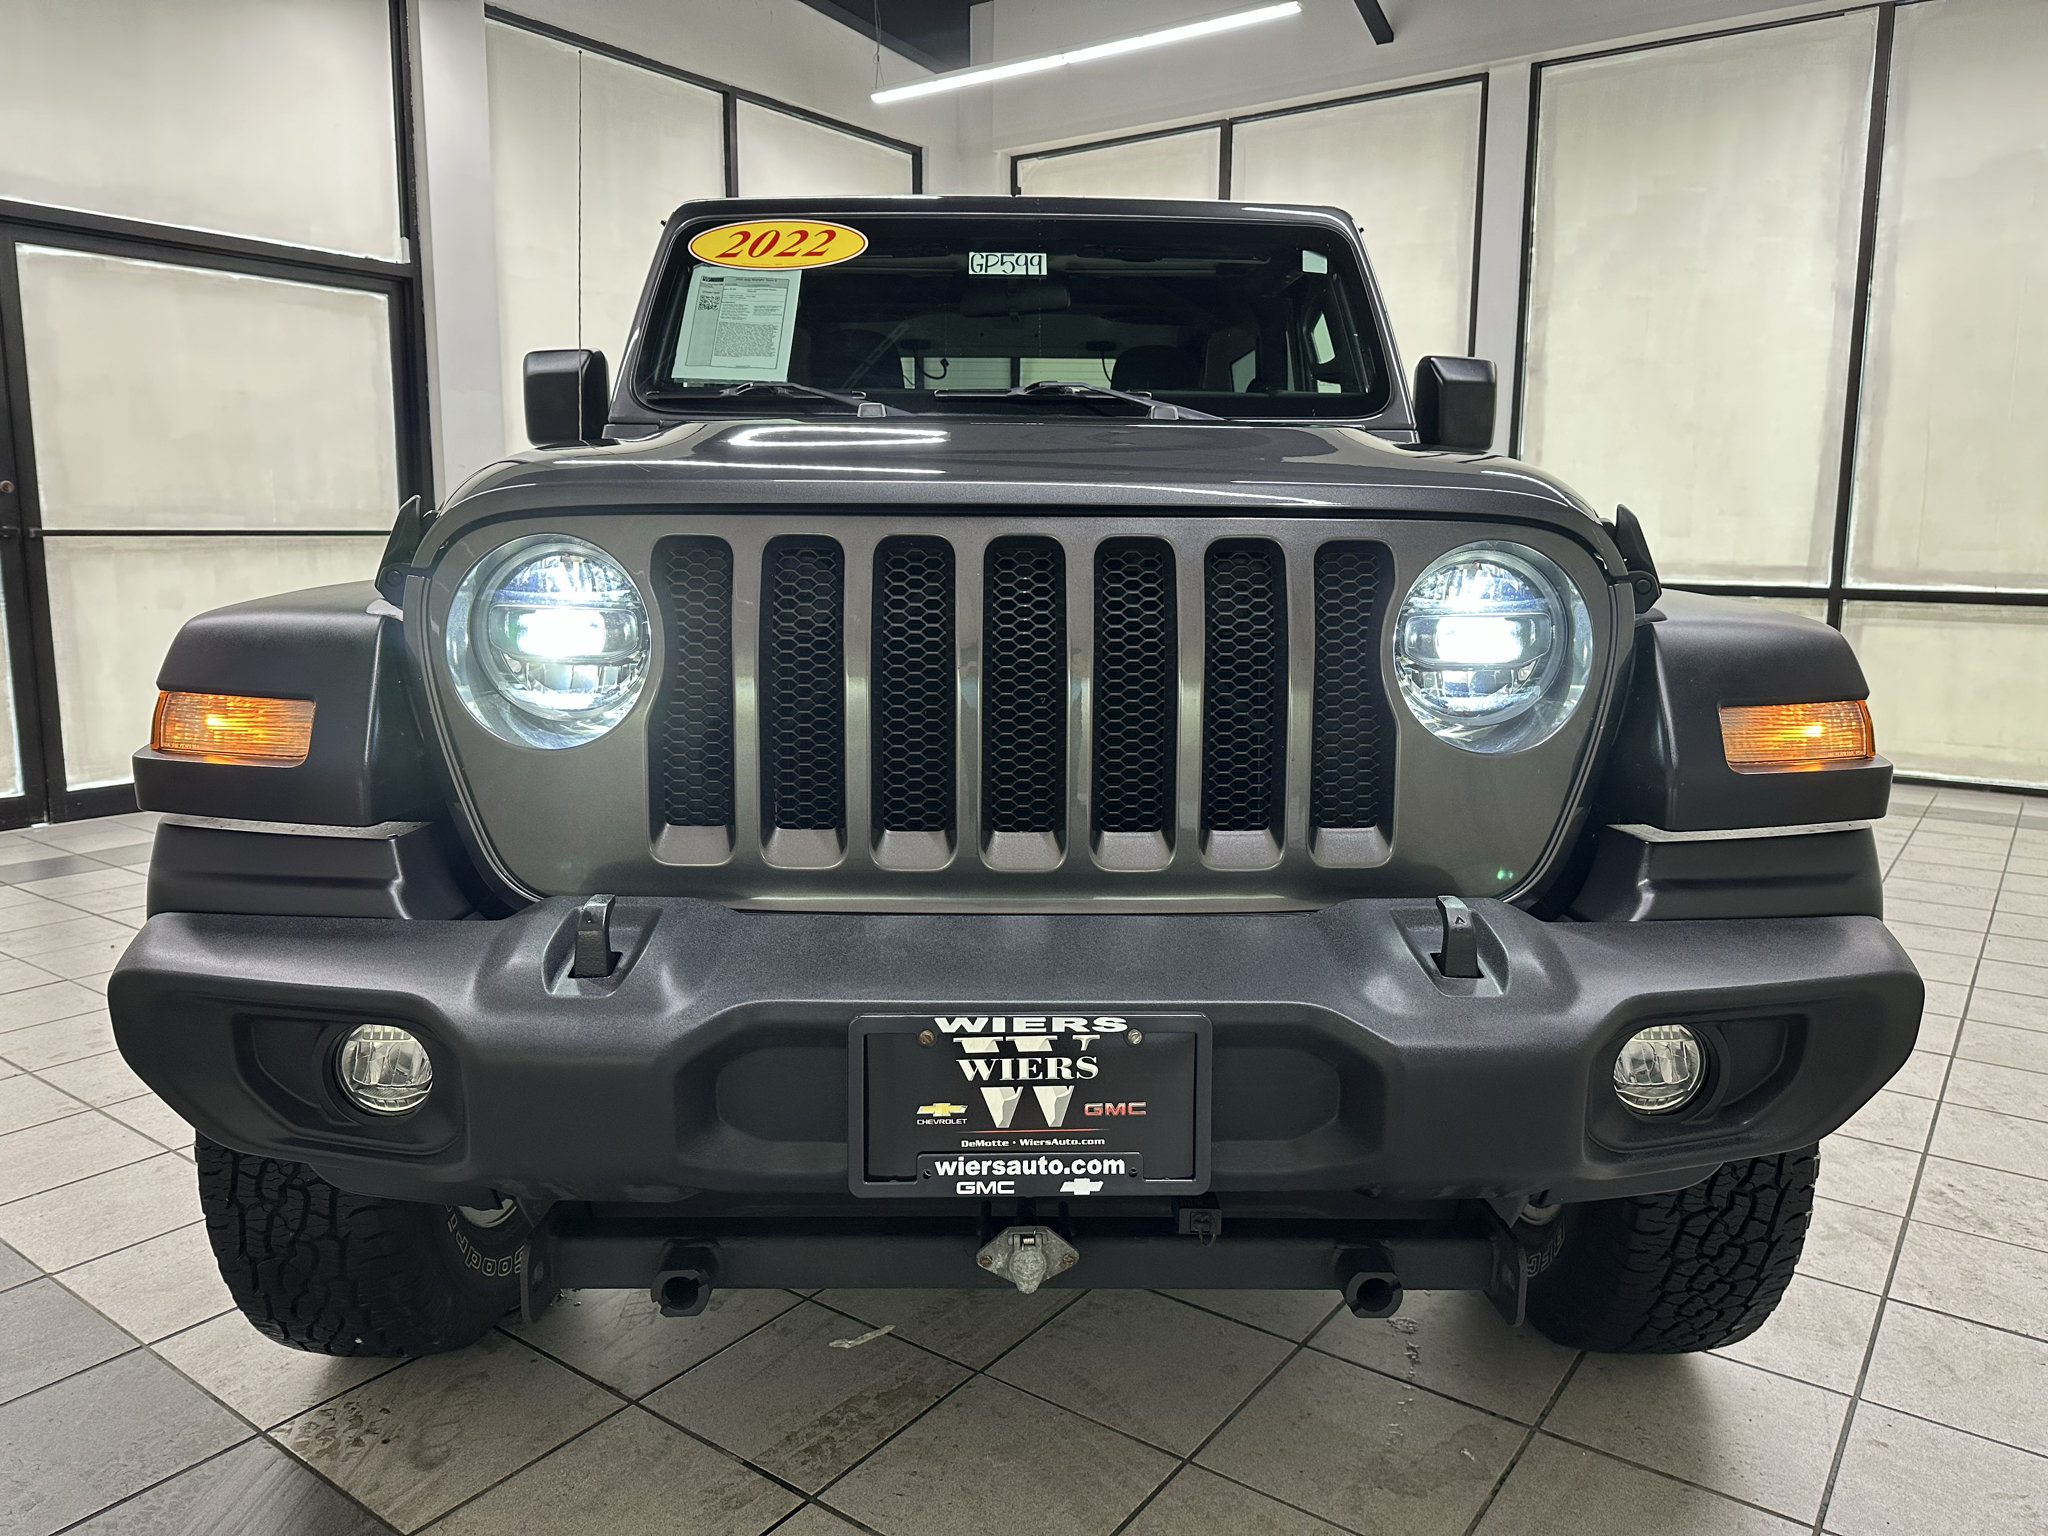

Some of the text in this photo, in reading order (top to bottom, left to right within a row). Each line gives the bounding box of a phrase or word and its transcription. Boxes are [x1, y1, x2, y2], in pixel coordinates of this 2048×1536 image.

[715, 229, 837, 258] 2022
[970, 253, 1042, 275] GP599
[934, 1017, 1128, 1033] WIERS
[956, 1056, 1099, 1081] WIERS
[1084, 1102, 1147, 1116] GMC
[961, 1138, 1105, 1148] DeMotte WiersAuto.com
[935, 1156, 1126, 1176] wiersauto.com
[956, 1181, 1015, 1195] GMC
